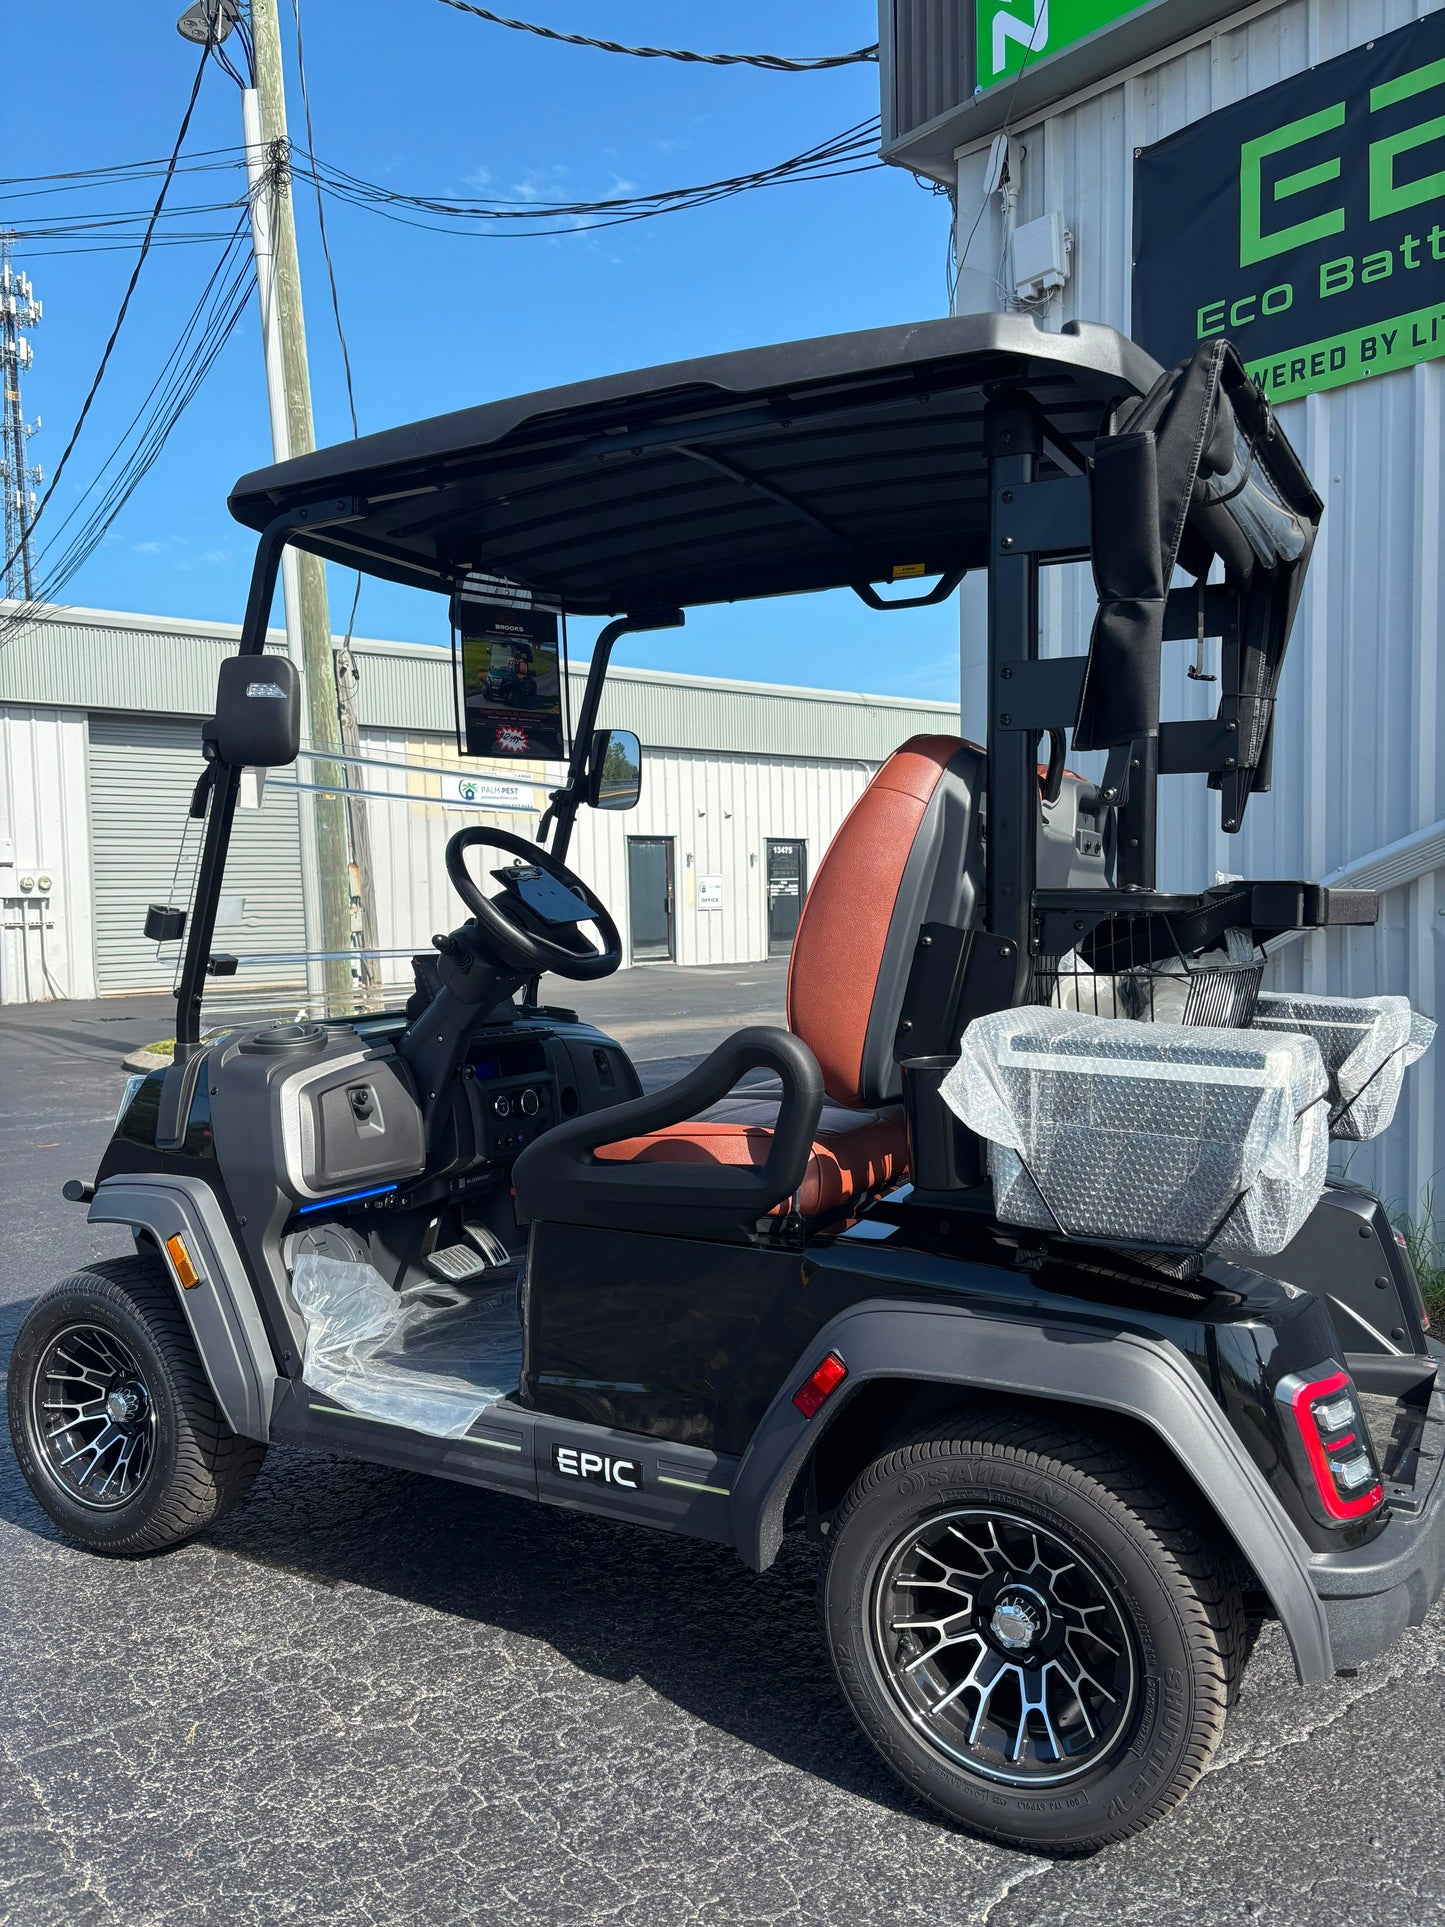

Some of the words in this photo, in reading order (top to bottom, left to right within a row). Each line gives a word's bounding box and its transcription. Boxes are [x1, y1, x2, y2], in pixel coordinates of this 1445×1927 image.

[1196, 283, 1294, 340] Eco
[1360, 329, 1398, 363] BY
[495, 624, 524, 632] BROOKS
[480, 786, 501, 794] PALM
[501, 787, 519, 795] PEST
[773, 846, 793, 854] 13475
[556, 1447, 638, 1488] EPIC
[928, 1462, 1069, 1507] SAILUN
